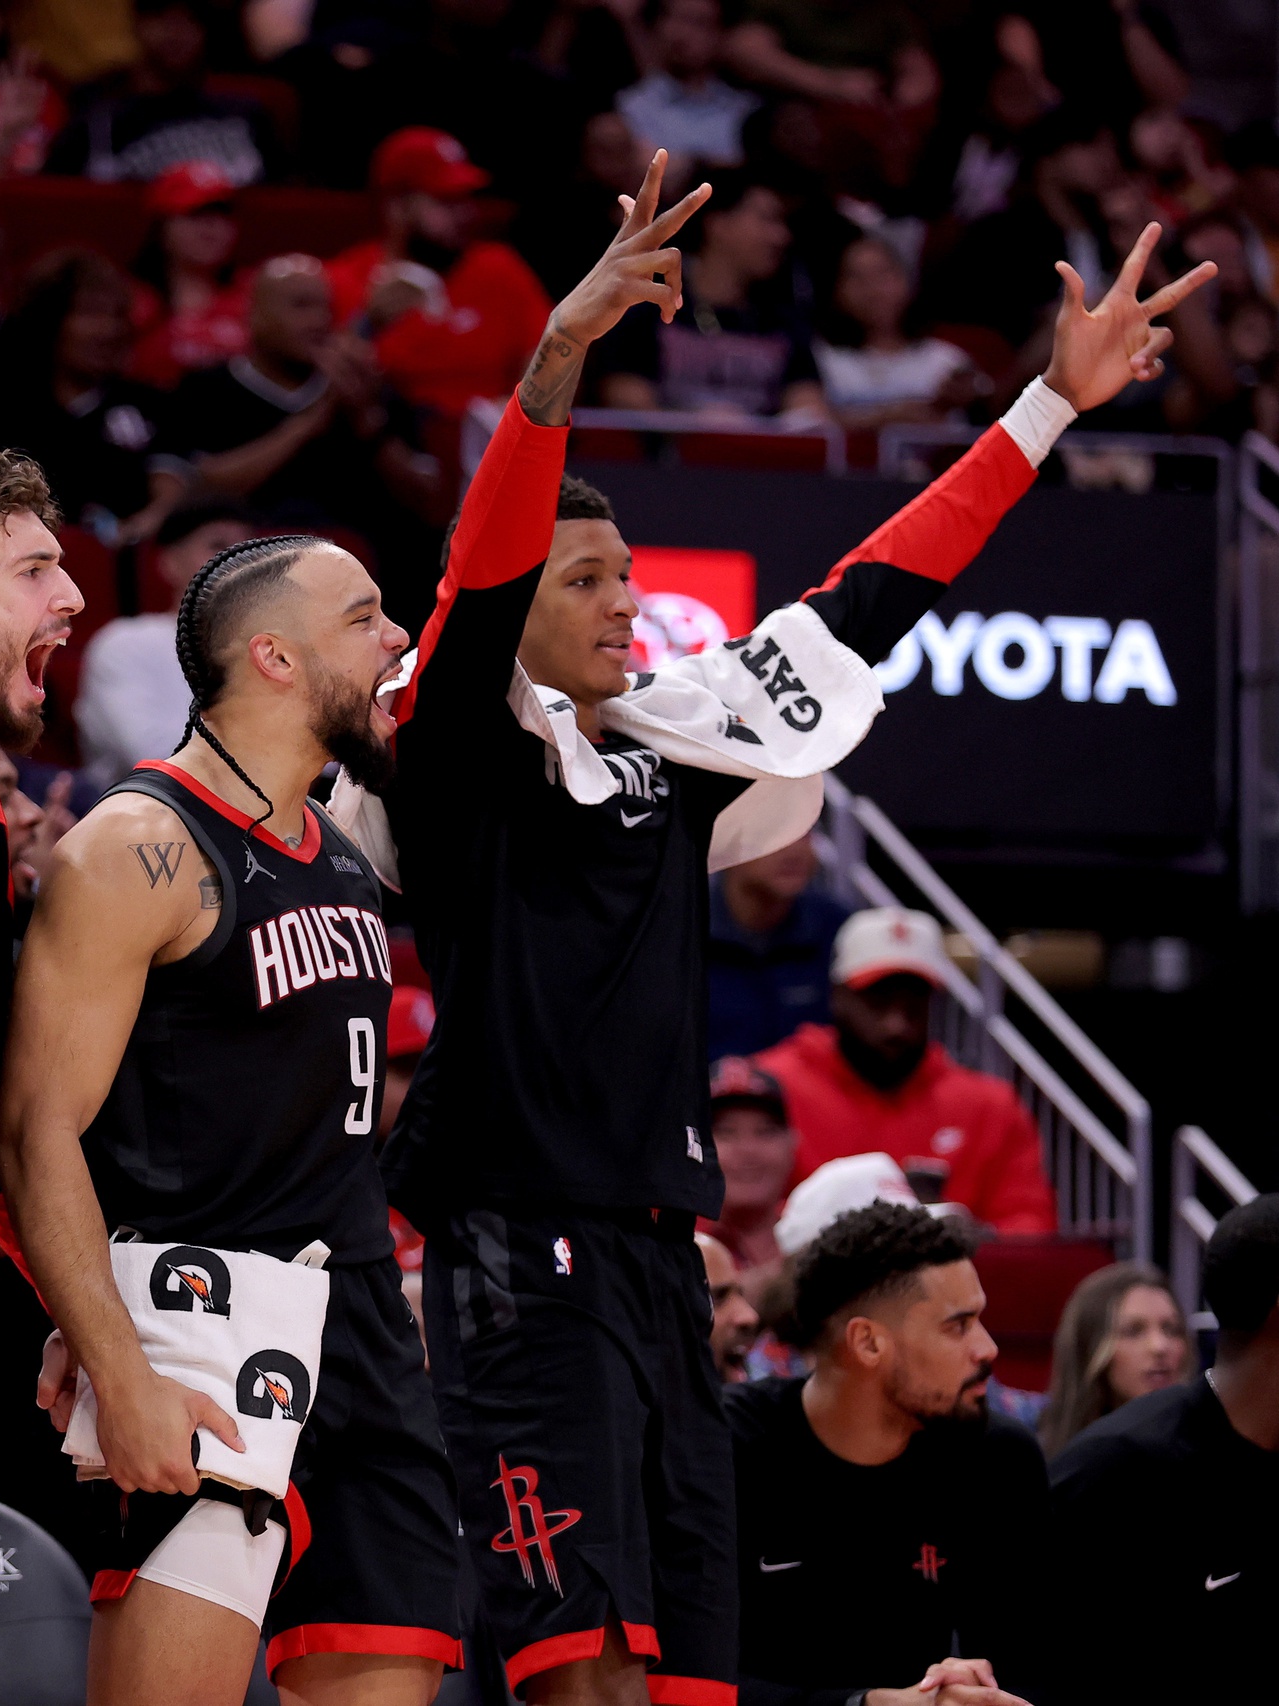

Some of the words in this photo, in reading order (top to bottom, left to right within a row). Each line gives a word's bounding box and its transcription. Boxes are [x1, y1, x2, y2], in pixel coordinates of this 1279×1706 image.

[871, 609, 1178, 707] YOTA
[248, 904, 393, 1010] HOUSTO
[344, 1017, 376, 1135] 9
